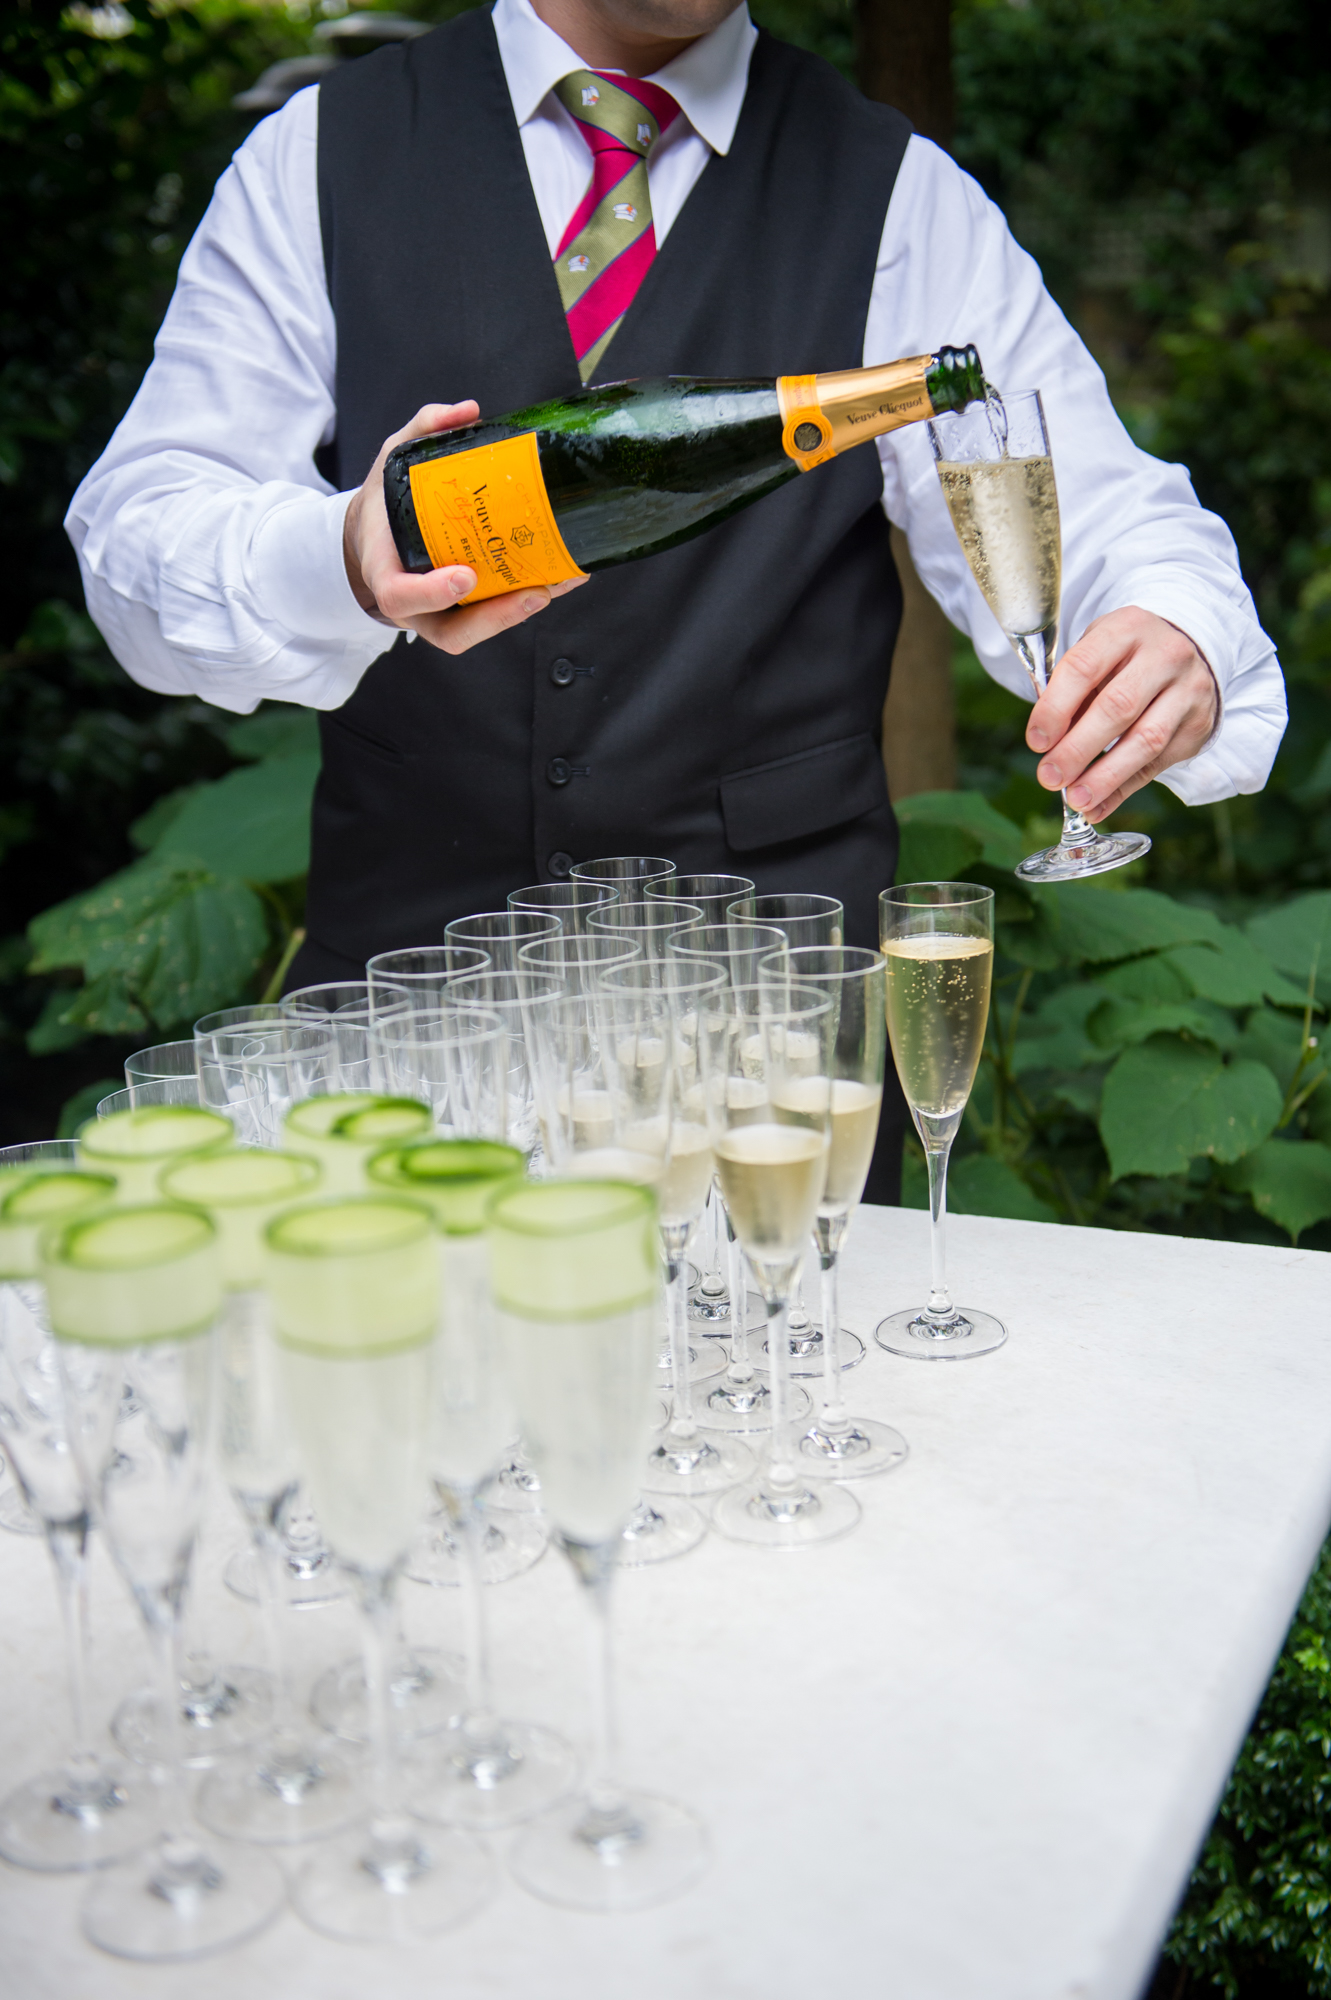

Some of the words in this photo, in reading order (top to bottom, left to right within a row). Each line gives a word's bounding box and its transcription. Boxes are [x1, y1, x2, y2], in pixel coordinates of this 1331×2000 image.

[847, 410, 878, 425] Veuve
[879, 397, 924, 415] Clicquot
[461, 538, 477, 564] BRUT
[473, 484, 493, 533] Veuve
[487, 536, 520, 585] Clicquot
[515, 483, 557, 571] CHAMPAGNE
